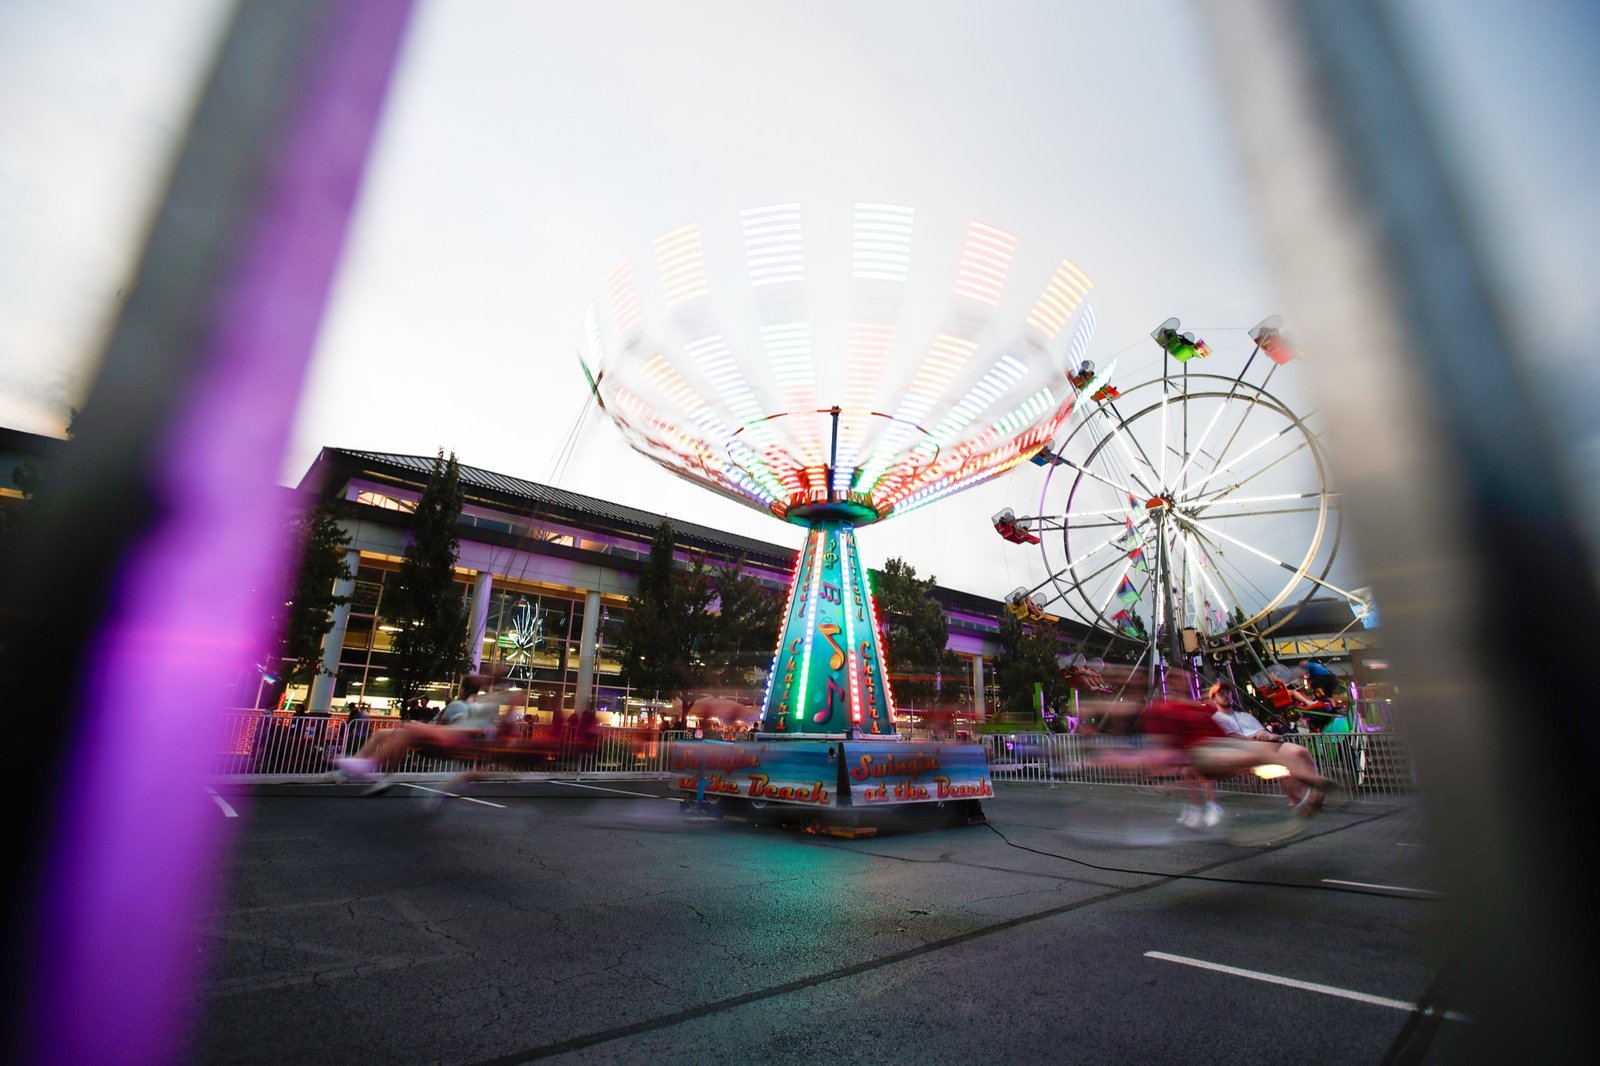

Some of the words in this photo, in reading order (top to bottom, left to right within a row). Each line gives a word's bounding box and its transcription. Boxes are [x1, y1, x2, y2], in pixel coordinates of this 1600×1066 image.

[775, 637, 801, 730] Chairs
[859, 640, 881, 733] Chairs
[851, 747, 940, 781] Swingin'
[678, 774, 698, 789] at
[747, 773, 829, 804] Beach
[864, 781, 888, 803] at
[894, 778, 931, 800] the
[933, 775, 992, 799] Beach
